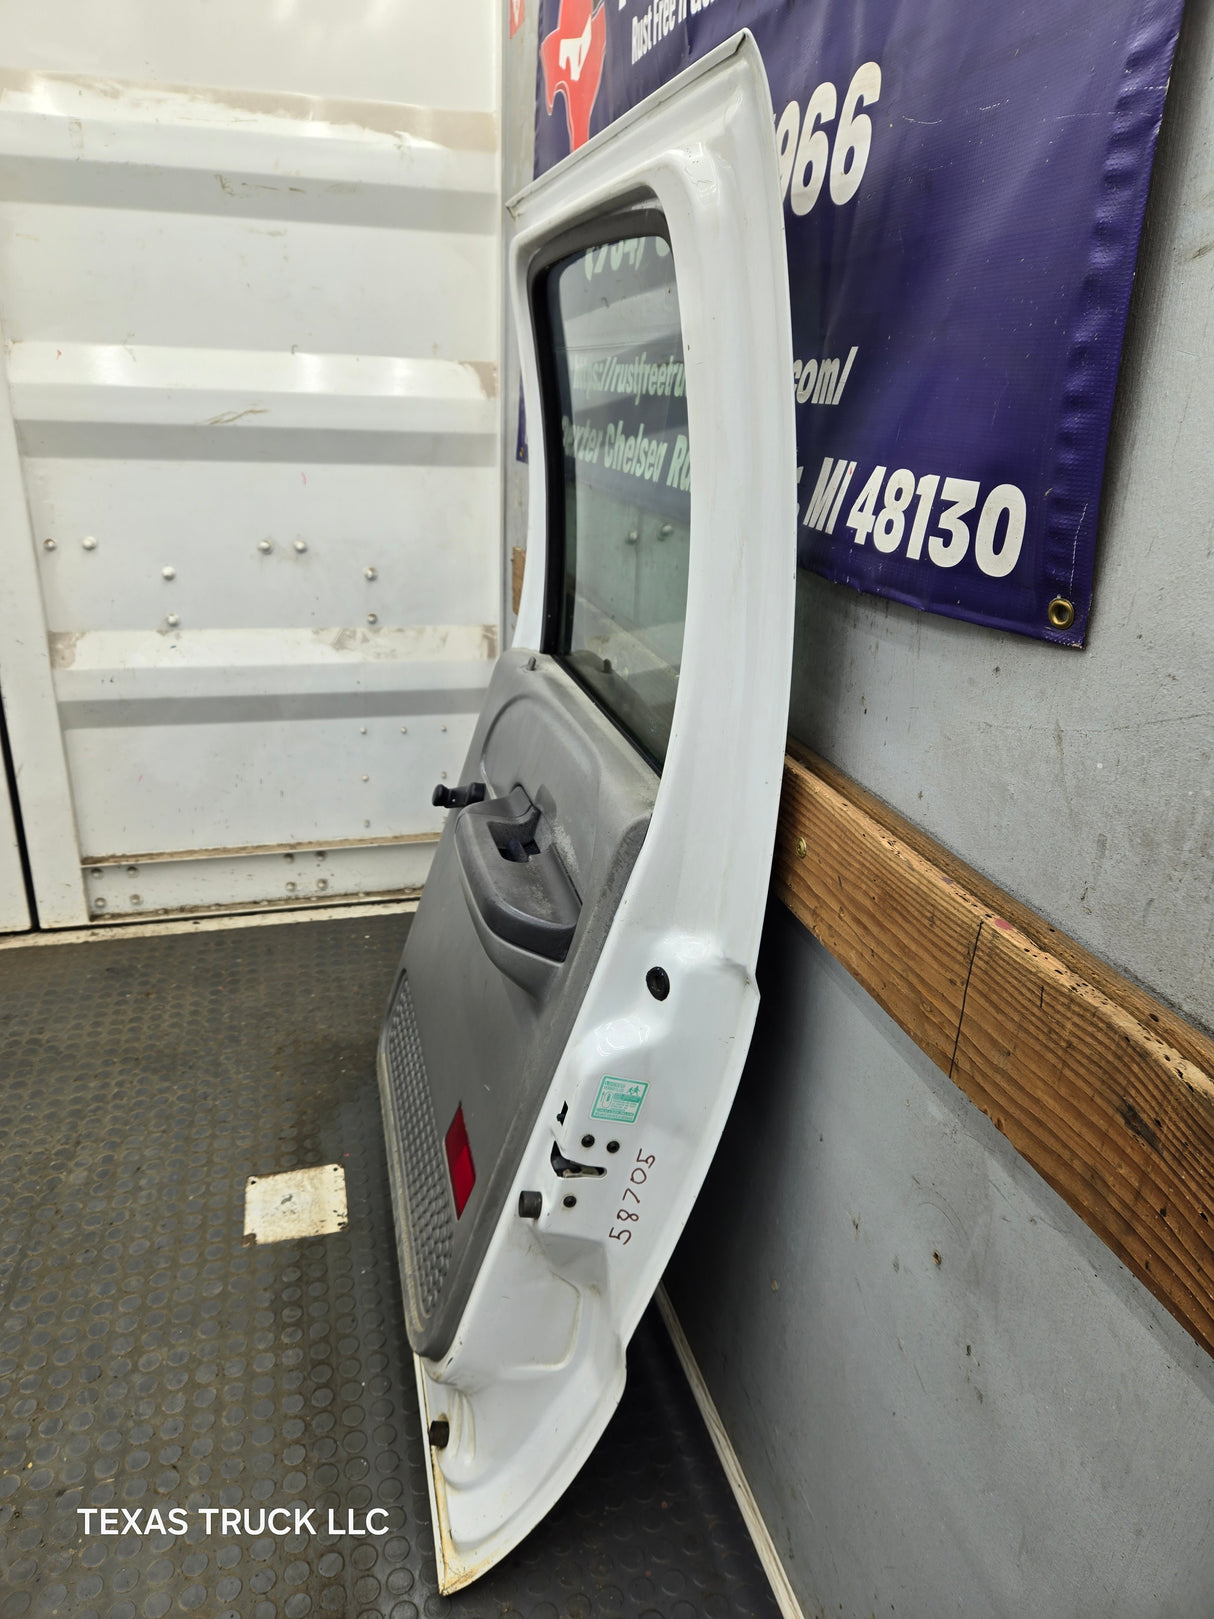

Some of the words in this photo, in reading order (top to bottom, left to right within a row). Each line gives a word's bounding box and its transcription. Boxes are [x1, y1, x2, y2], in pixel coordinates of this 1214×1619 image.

[631, 5, 653, 65] Rust
[653, 0, 676, 46] Free
[802, 457, 858, 535] MI
[846, 465, 1027, 577] 48130
[608, 1148, 656, 1246] 58705
